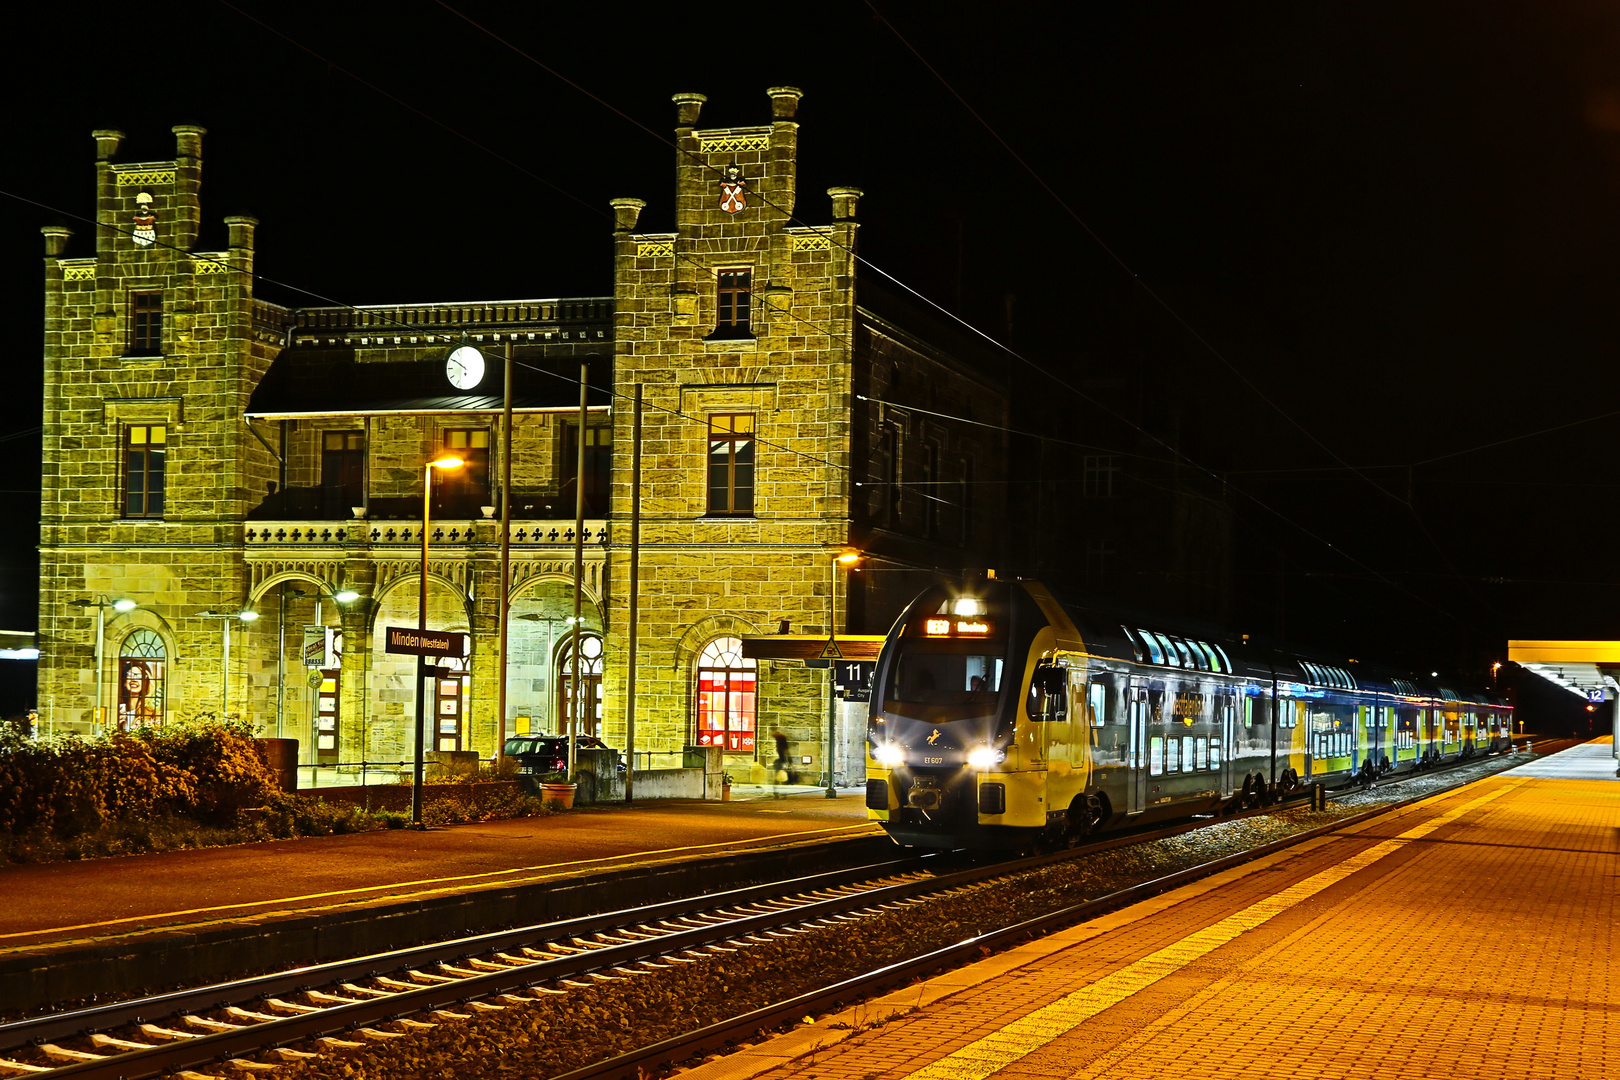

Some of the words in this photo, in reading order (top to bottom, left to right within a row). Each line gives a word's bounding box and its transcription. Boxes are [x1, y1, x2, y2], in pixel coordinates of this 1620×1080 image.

[957, 621, 988, 633] Rheine
[391, 631, 419, 647] Minden
[420, 636, 450, 651] (Westfalen)
[846, 664, 860, 681] 11
[1590, 690, 1602, 700] 12
